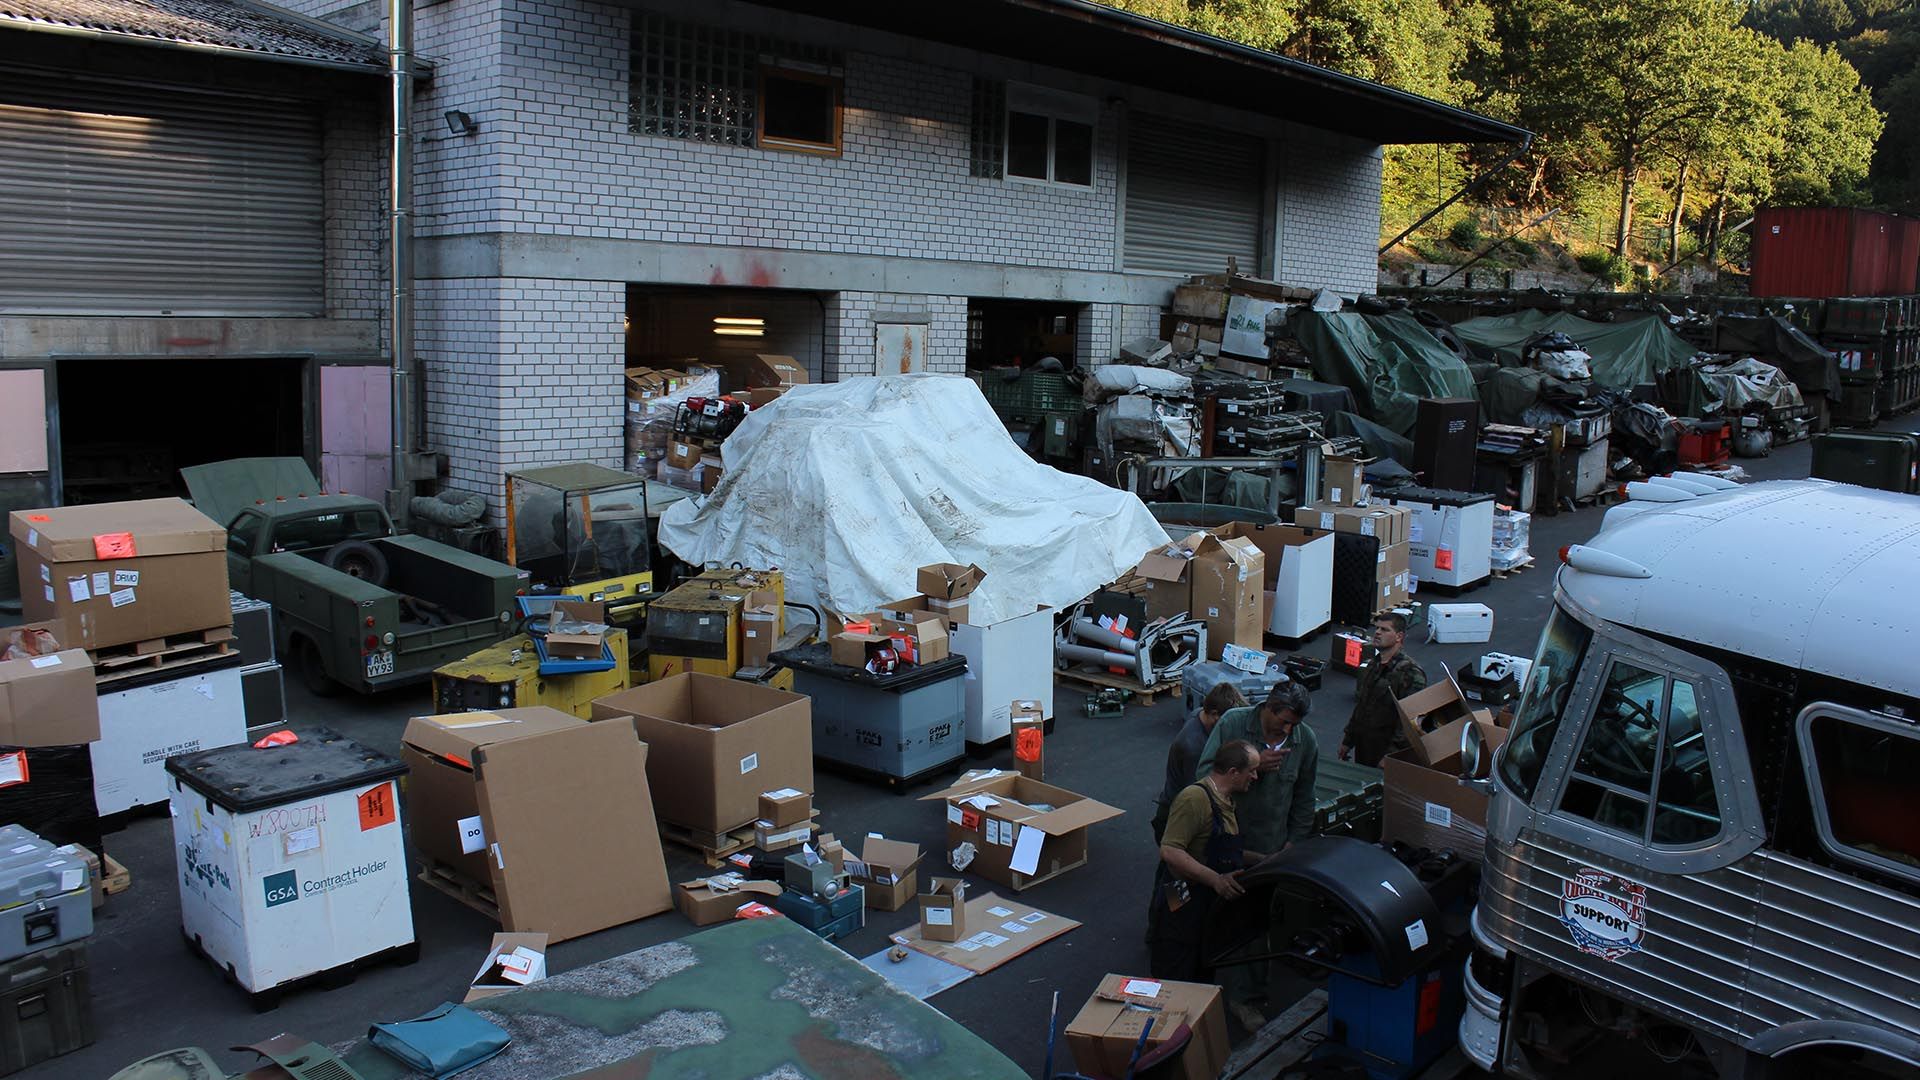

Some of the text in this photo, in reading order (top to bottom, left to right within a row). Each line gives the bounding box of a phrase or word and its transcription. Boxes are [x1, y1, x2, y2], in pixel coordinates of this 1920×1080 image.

[115, 573, 138, 583] DRMO
[373, 655, 386, 665] AK
[142, 739, 200, 758] HANDLE WITH CARE
[468, 828, 481, 838] DO
[303, 870, 351, 893] Contract
[352, 859, 388, 879] Holder
[267, 886, 297, 902] GSA
[1573, 903, 1630, 933] SUPPORT
